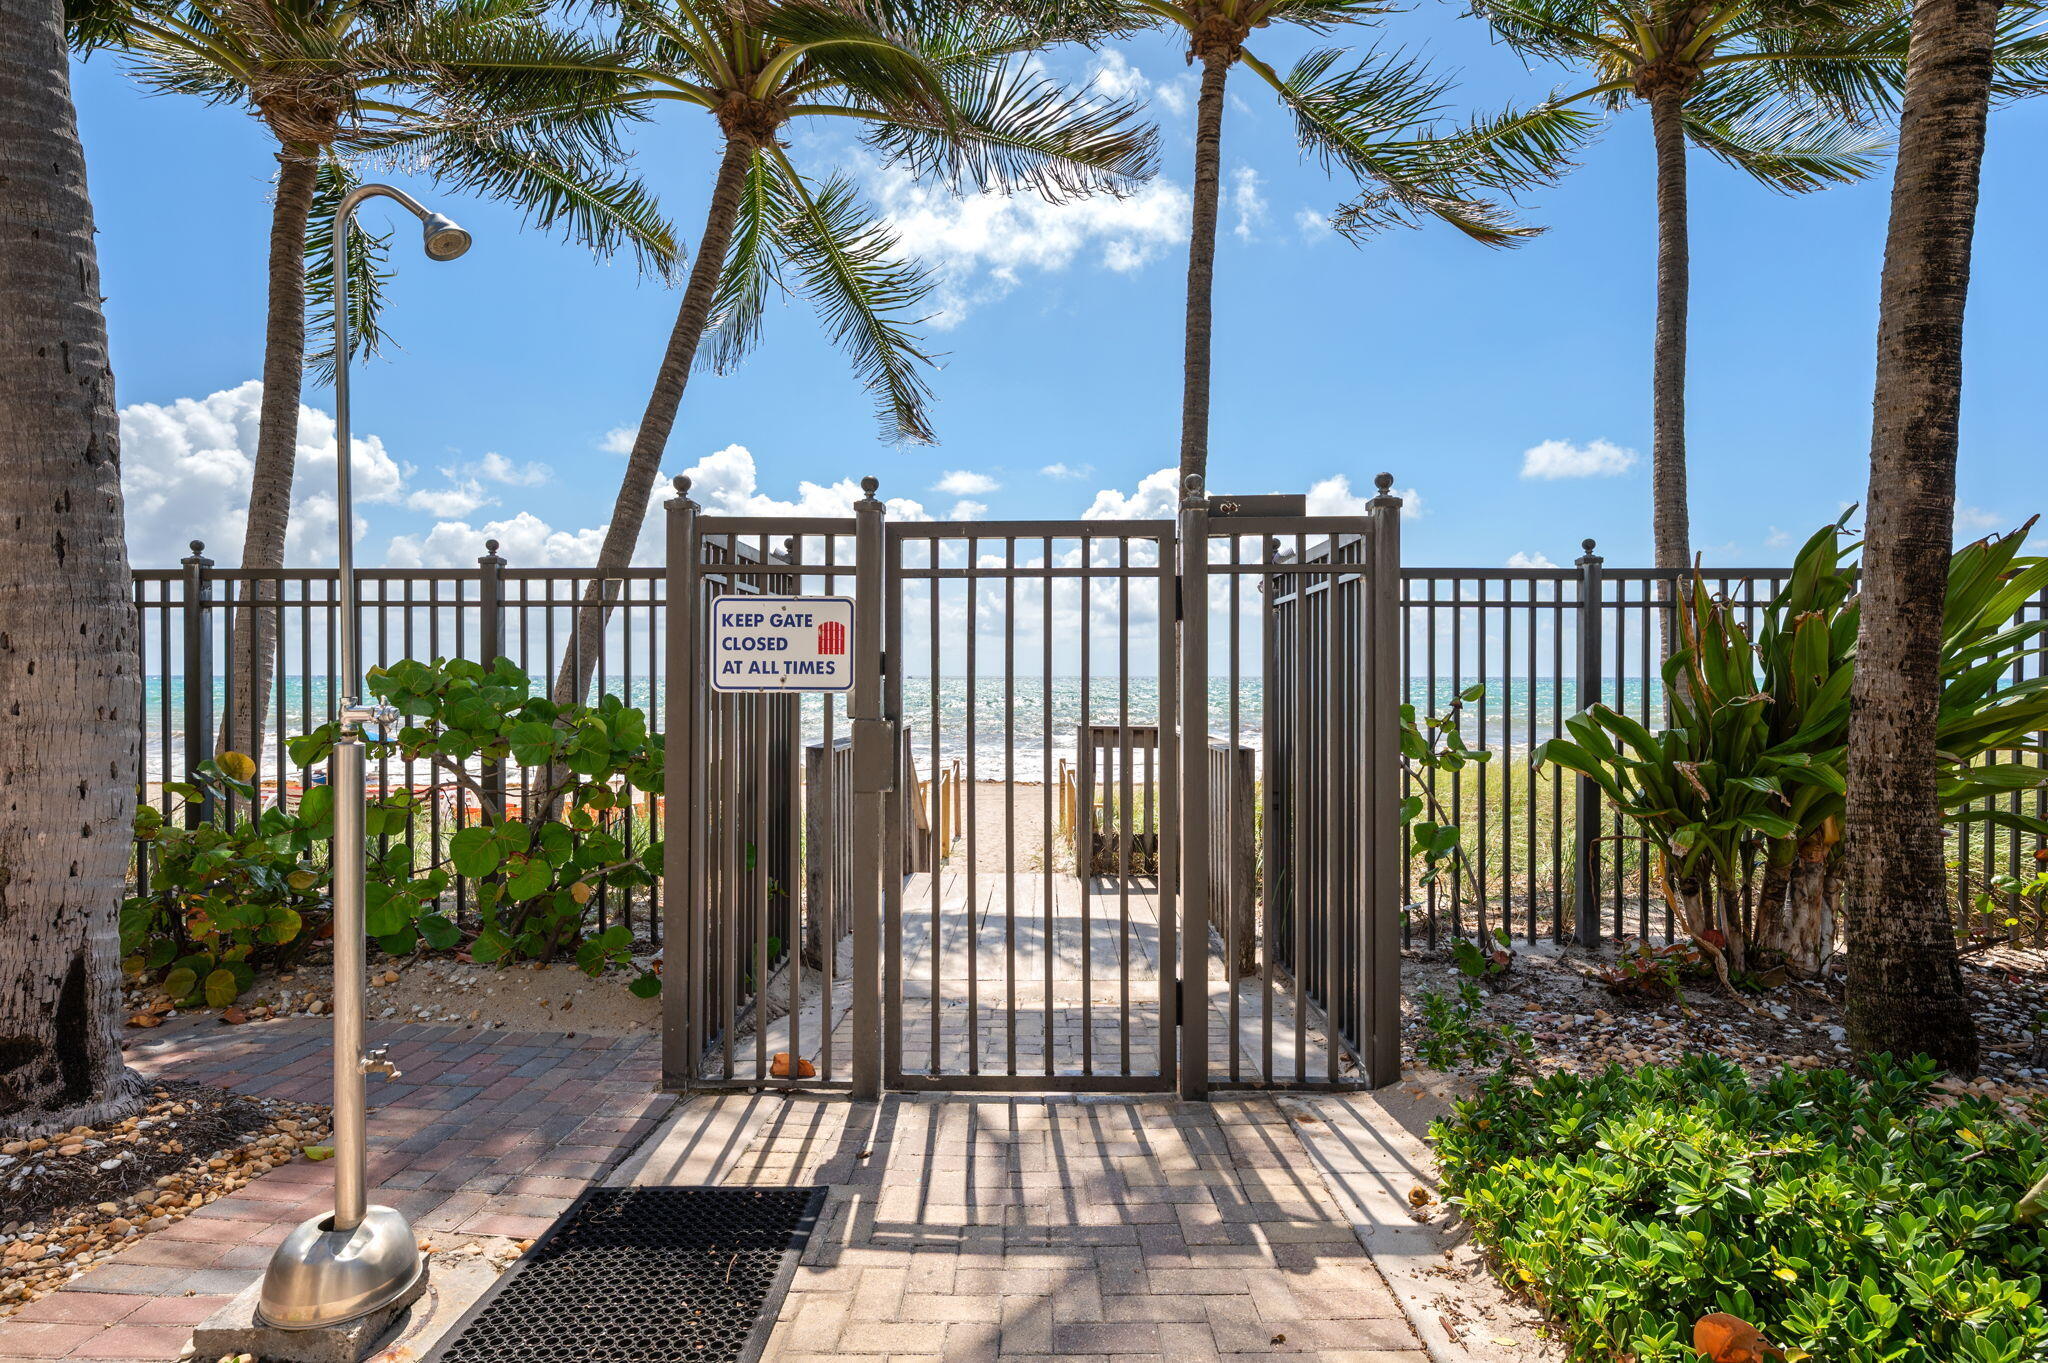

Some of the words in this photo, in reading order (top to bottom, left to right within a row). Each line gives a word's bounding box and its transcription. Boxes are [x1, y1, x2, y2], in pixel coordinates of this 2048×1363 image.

[722, 613, 764, 627] KEEP
[769, 613, 813, 627] GATE
[722, 637, 788, 651] CLOSED
[722, 660, 743, 674] AT
[748, 660, 779, 674] ALL
[783, 660, 835, 675] TIMES
